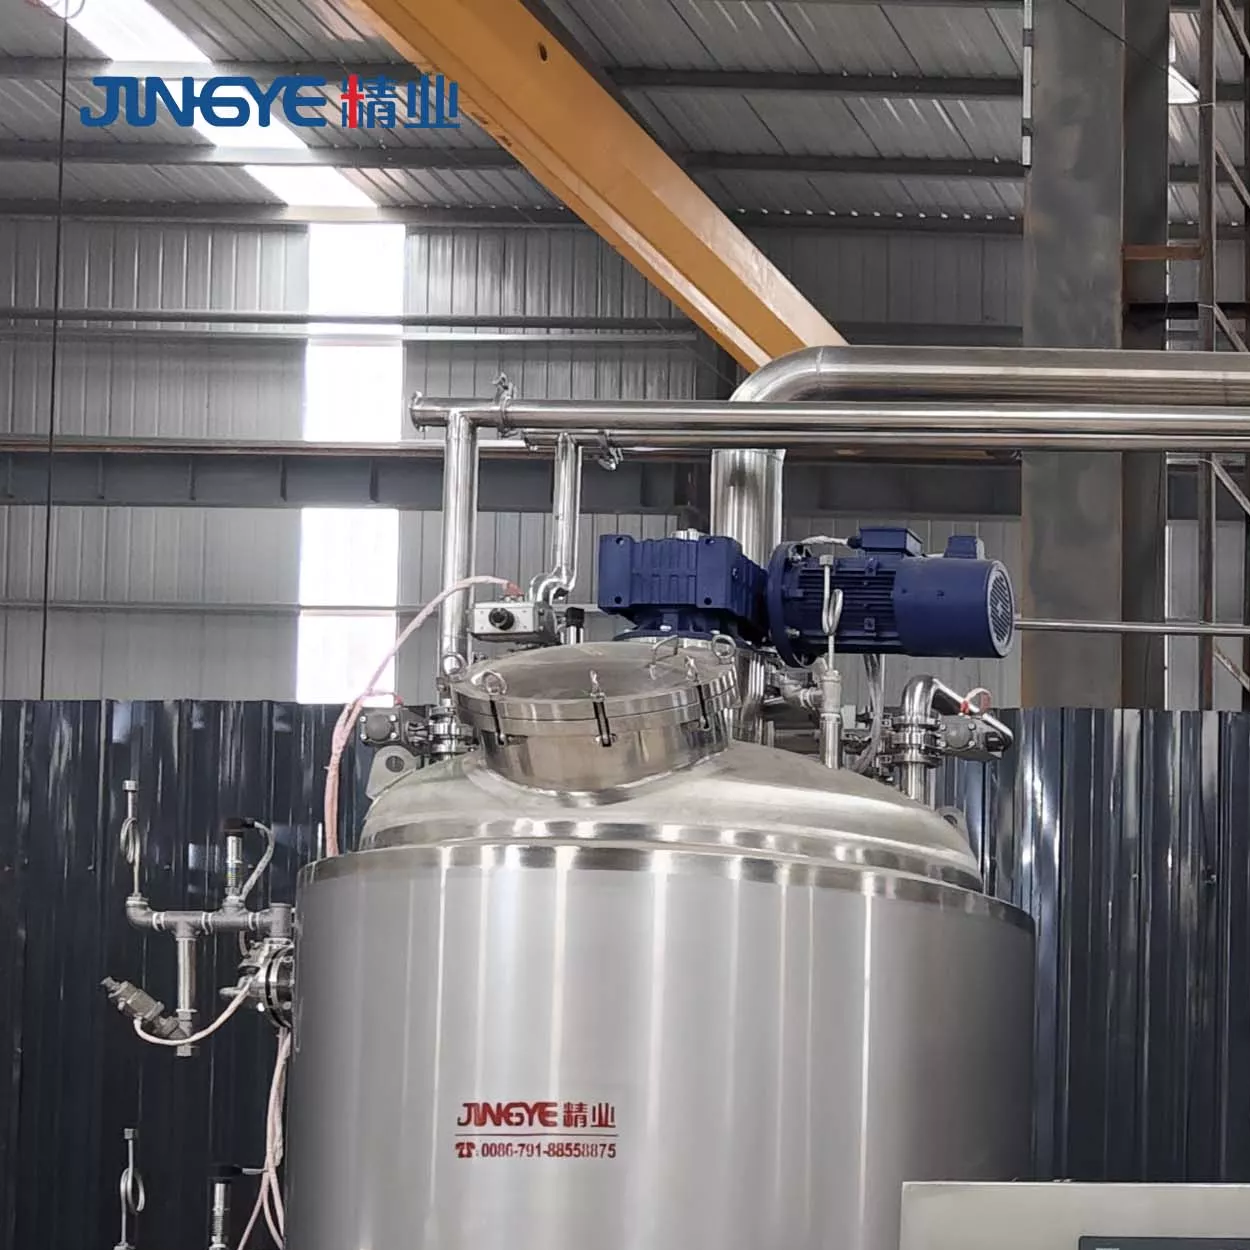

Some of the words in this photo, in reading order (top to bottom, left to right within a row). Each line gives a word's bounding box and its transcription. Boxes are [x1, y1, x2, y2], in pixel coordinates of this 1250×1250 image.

[457, 1101, 558, 1128] JINGYE
[562, 1101, 616, 1129] 精业
[481, 1142, 617, 1158] 0086-791-88558875
